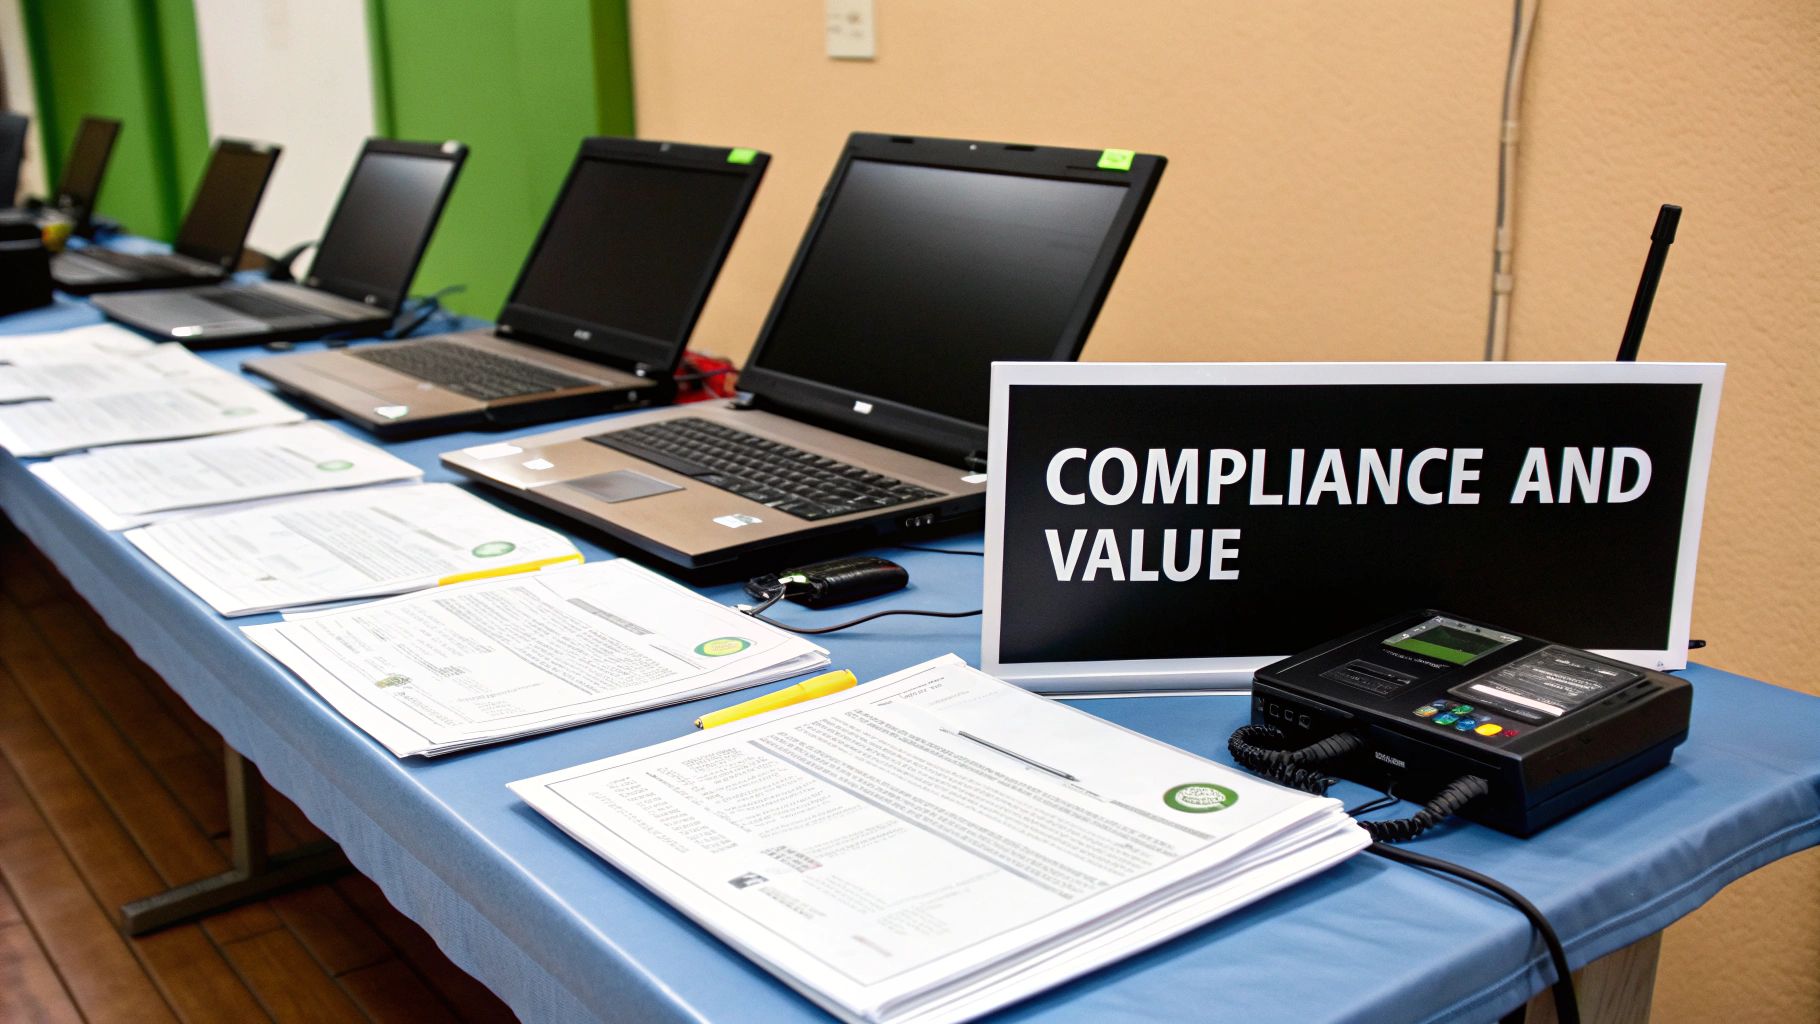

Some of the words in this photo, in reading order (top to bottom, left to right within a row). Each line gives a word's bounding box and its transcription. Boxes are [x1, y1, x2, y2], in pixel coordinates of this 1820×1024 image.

[1046, 447, 1484, 506] COMPLIANCE
[1510, 446, 1652, 504] AND
[1044, 528, 1241, 582] VALUE
